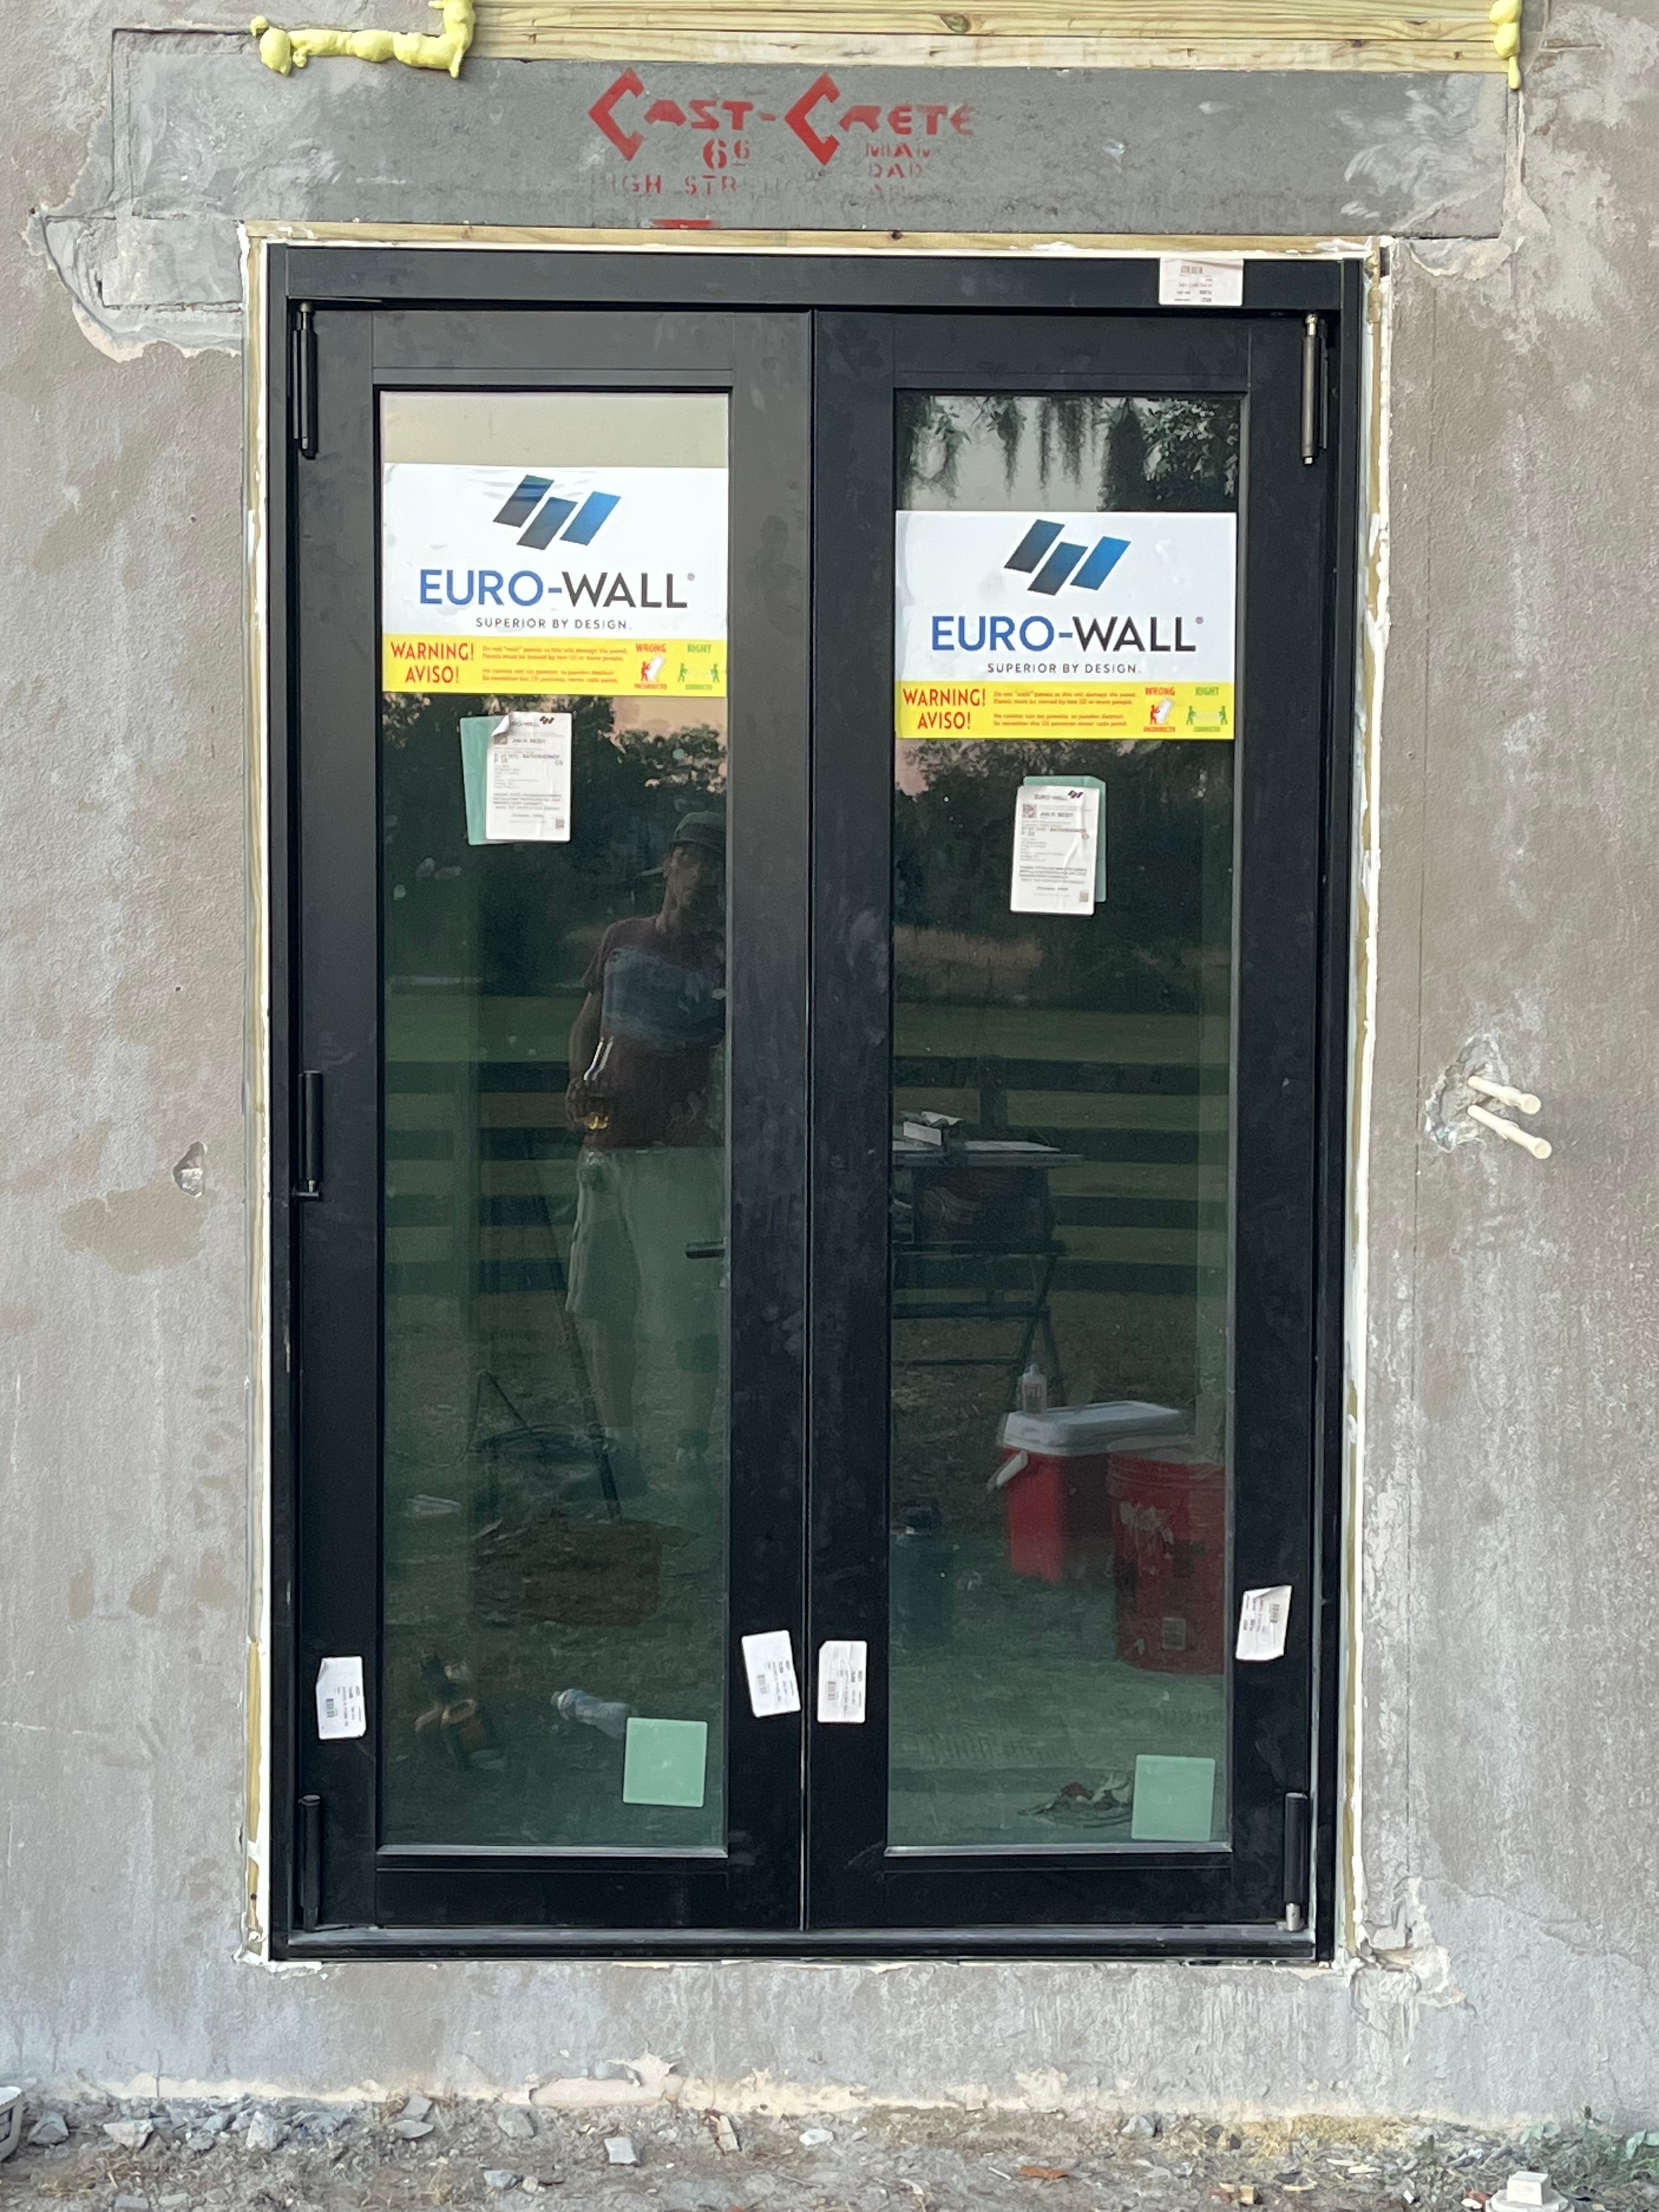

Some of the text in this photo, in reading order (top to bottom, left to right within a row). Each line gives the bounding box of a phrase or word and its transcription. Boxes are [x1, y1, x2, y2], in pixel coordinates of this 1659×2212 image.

[589, 67, 976, 166] CAST-CRETE
[476, 617, 546, 628] SUPERIOR
[552, 619, 569, 629] BY
[391, 642, 475, 661] WARNING!
[635, 643, 666, 653] WRONG
[687, 644, 712, 653] RIGHT
[987, 663, 1056, 673] SUPERIOR
[1062, 663, 1080, 673] BY
[406, 666, 459, 684] AVISO!
[903, 688, 986, 706] WARNING!
[1145, 687, 1176, 696] WRONG
[1195, 687, 1219, 696] RIGHT
[918, 711, 971, 729] AVISO!
